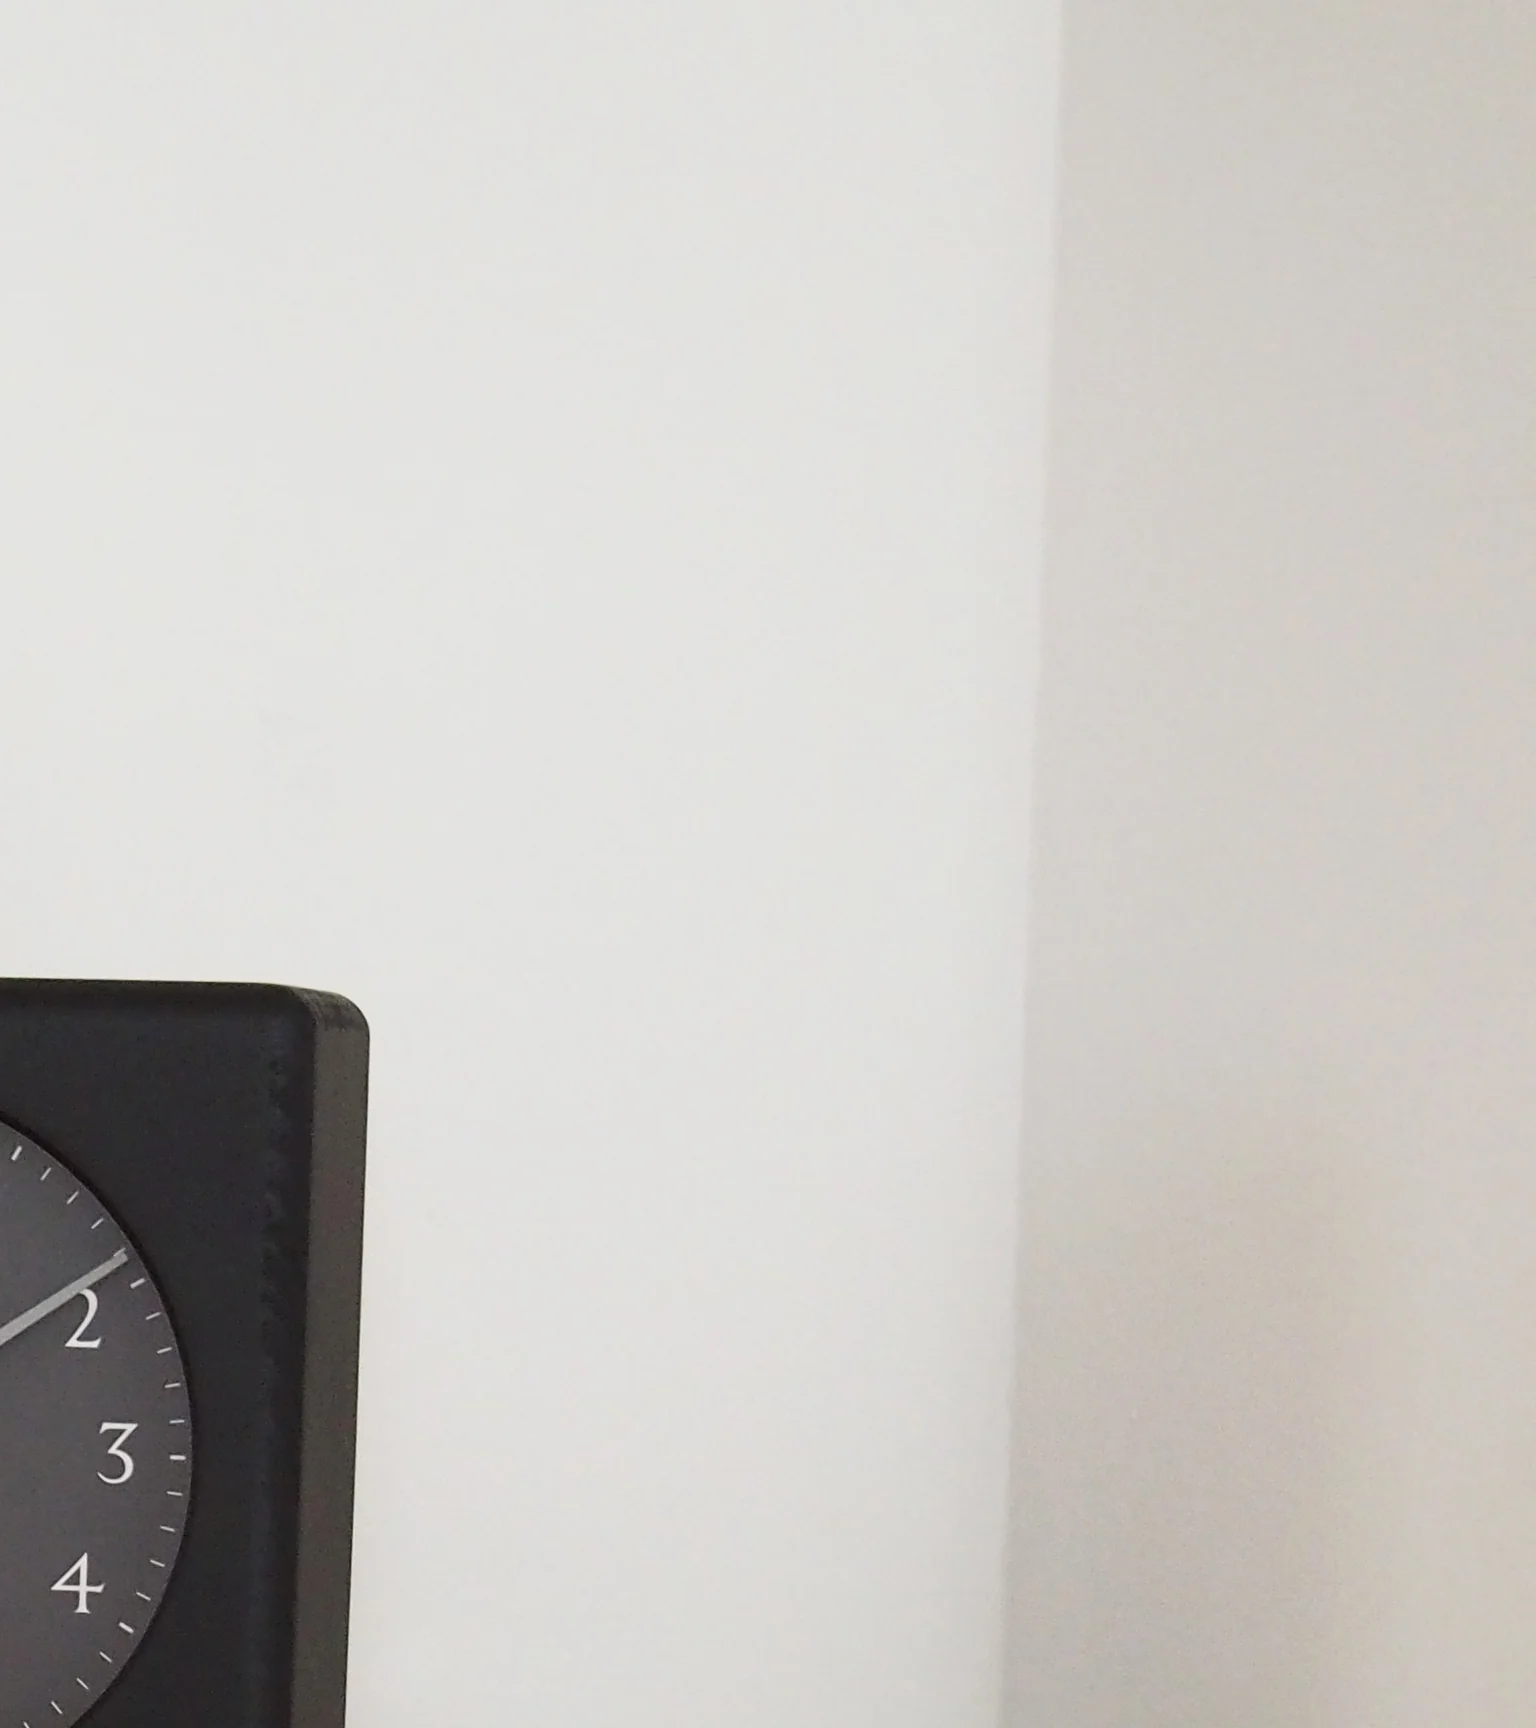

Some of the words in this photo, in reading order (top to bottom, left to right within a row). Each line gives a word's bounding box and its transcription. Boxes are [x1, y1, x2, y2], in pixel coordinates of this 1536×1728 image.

[64, 1288, 102, 1349] 2
[96, 1421, 136, 1484] 3
[50, 1552, 105, 1614] 4
